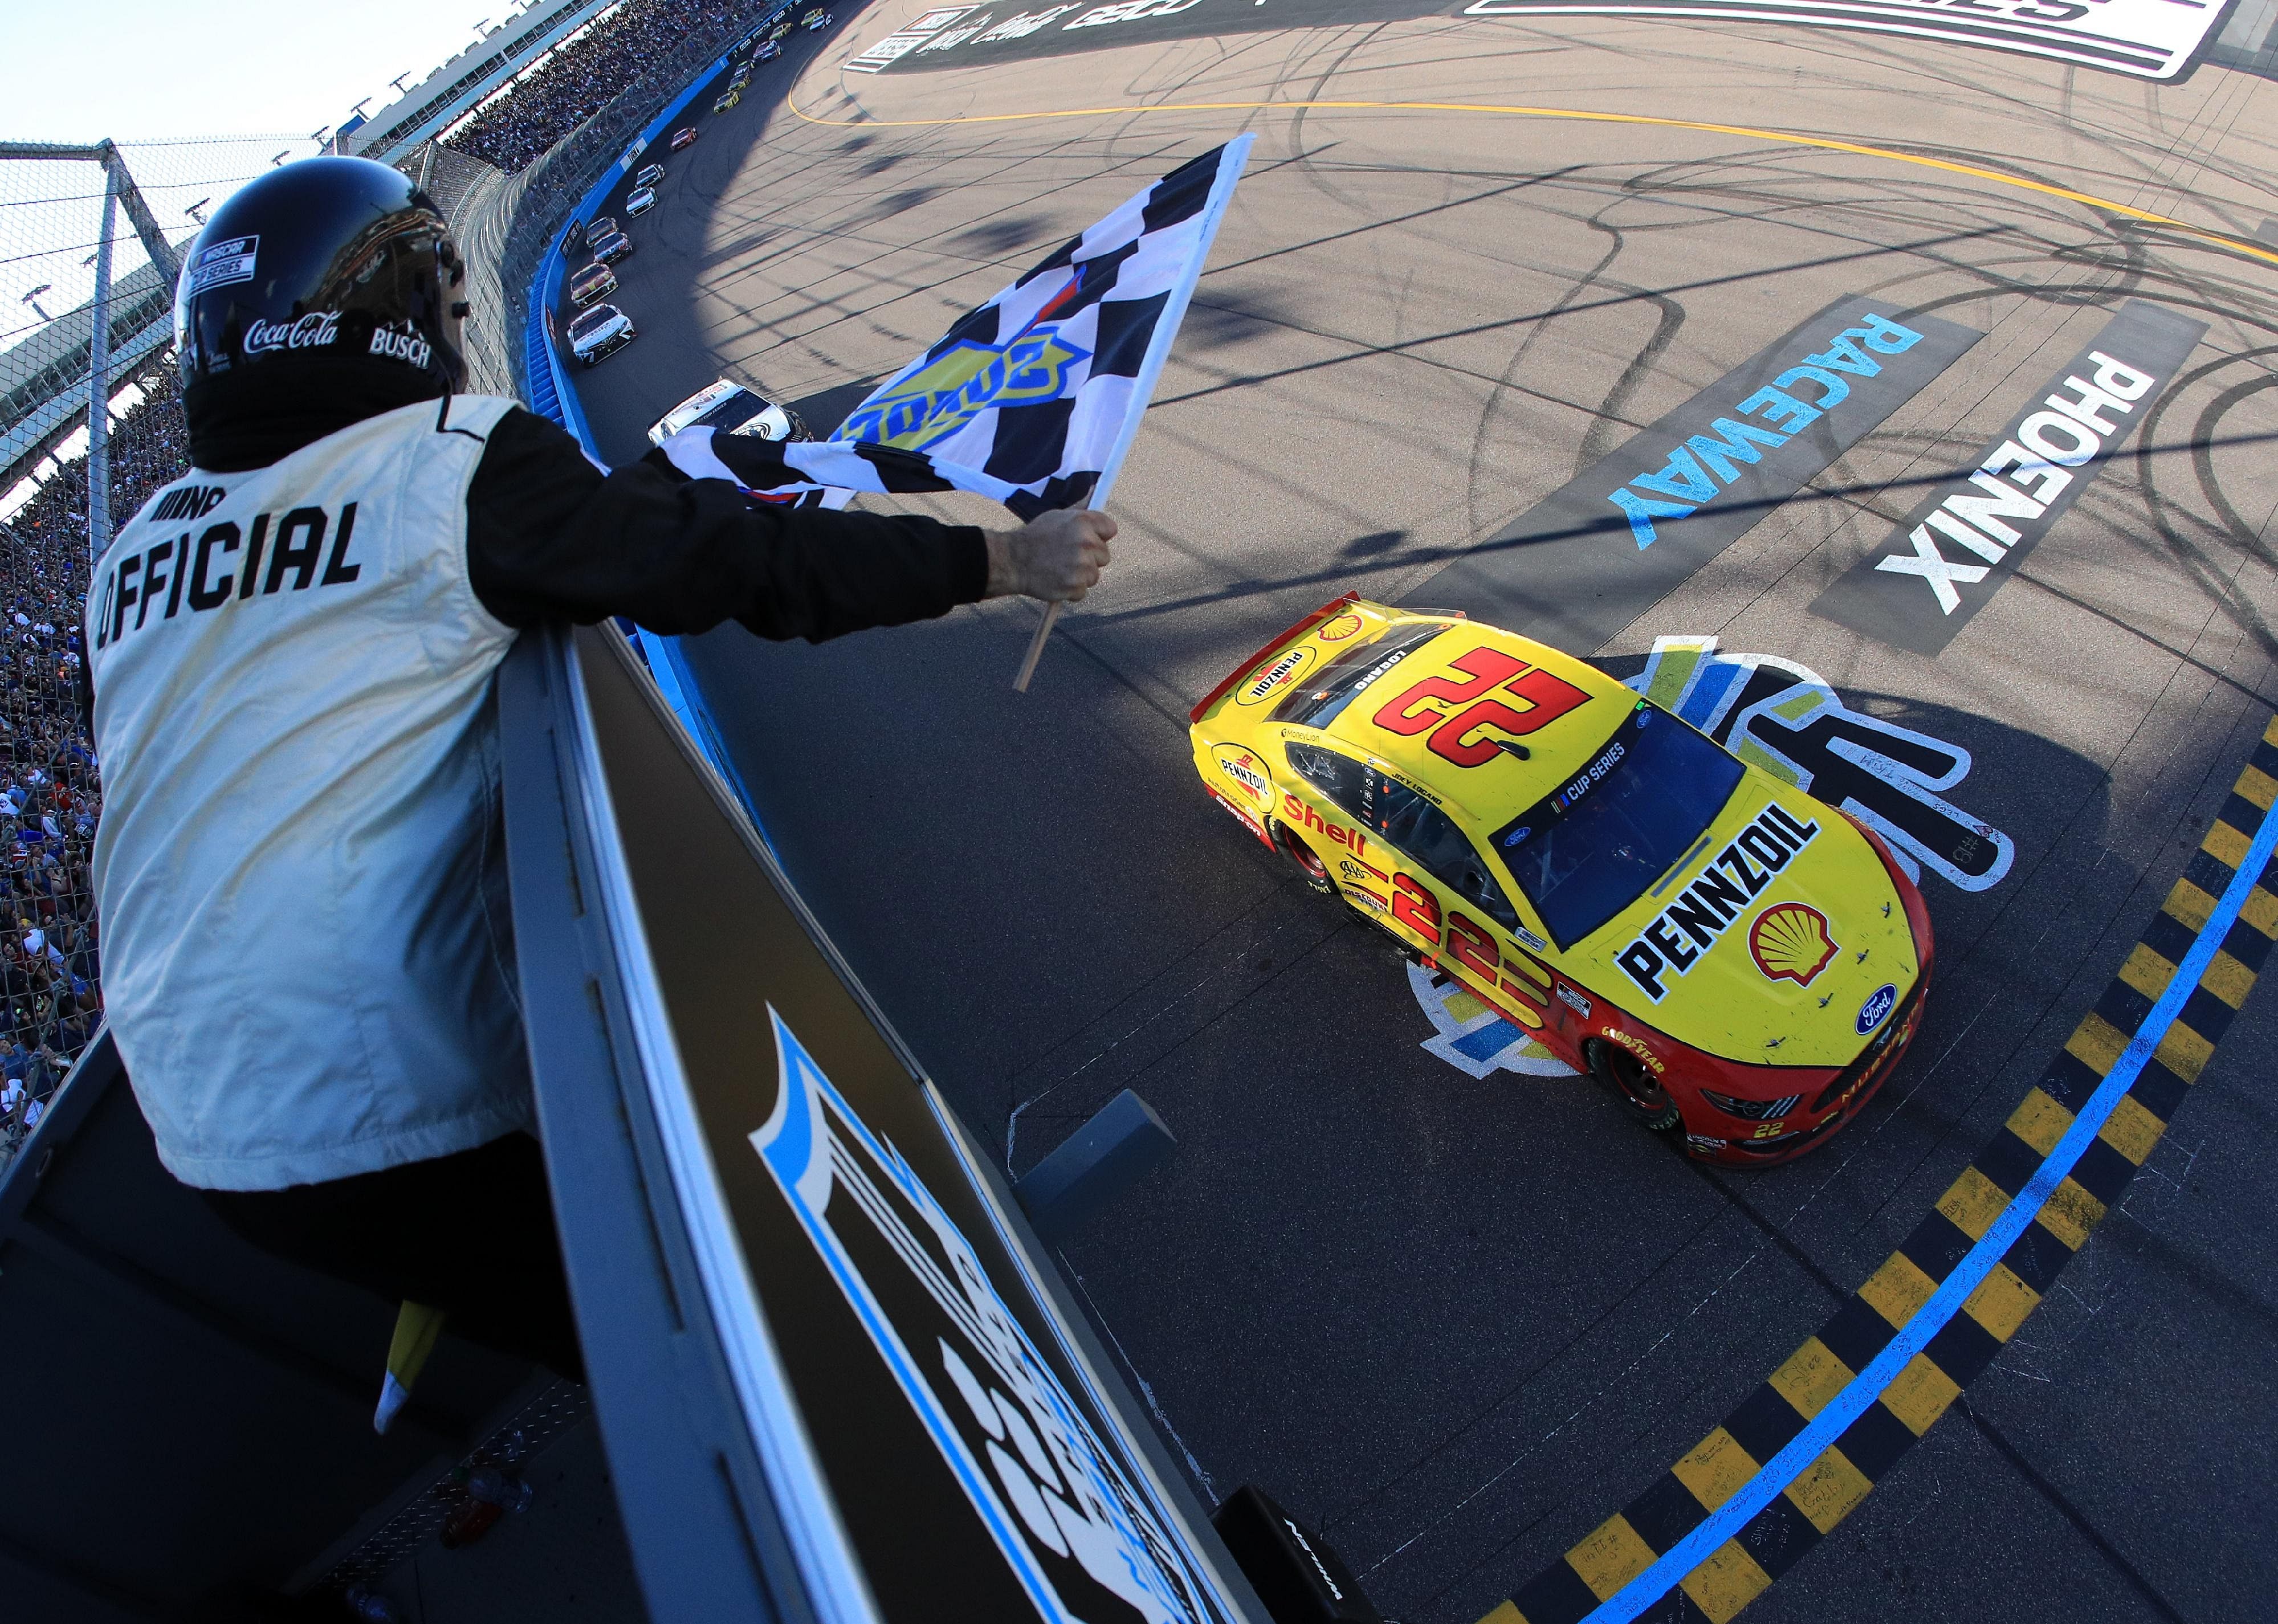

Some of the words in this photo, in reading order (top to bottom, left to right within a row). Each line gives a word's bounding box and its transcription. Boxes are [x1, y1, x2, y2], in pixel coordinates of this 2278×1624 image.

[243, 310, 344, 354] Coca-Cola
[368, 326, 431, 370] BUSCH
[1607, 312, 1924, 550] RACEWAY
[1874, 350, 2155, 615] PHOENIX
[97, 501, 361, 650] OFFICIAL
[1249, 652, 1303, 697] PENNZOIL
[1354, 650, 1407, 691] LOGANO
[1373, 646, 1594, 768] 22
[1286, 729, 1320, 742] MoneyLion
[1221, 758, 1268, 795] PENNZOIL
[1391, 773, 1412, 785] JOEY
[1412, 783, 1443, 805] LOGANO
[1567, 775, 1590, 801] CUP
[1589, 742, 1625, 781] SERIES
[1283, 794, 1367, 857] Shell
[1342, 861, 1364, 879] AAA
[1344, 888, 1388, 912] DISCOUNT
[1614, 801, 1821, 1004] PENNZOIL
[1391, 871, 1500, 988] 22
[1862, 991, 1891, 1026] Ford
[1753, 1121, 1784, 1139] 22
